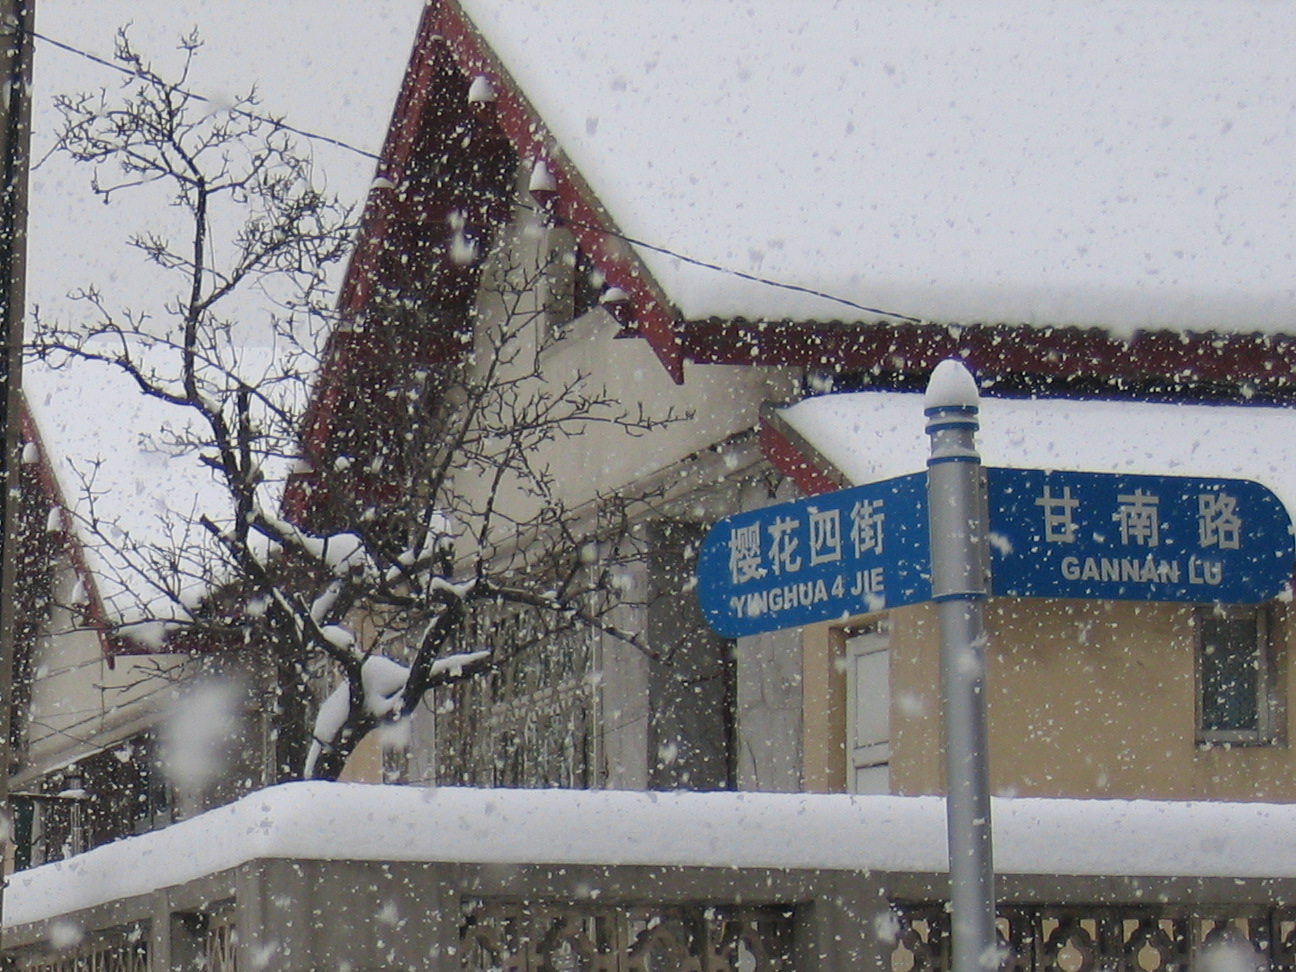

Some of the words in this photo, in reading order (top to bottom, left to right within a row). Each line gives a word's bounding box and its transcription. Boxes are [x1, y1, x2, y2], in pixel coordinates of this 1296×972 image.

[728, 499, 885, 584] 樱花四街
[1035, 485, 1242, 549] 甘南路
[730, 579, 828, 618] YINGHUA
[831, 575, 845, 598] 4
[851, 567, 884, 596] JIE
[1061, 556, 1179, 583] GANNAN
[1188, 556, 1222, 585] LU
